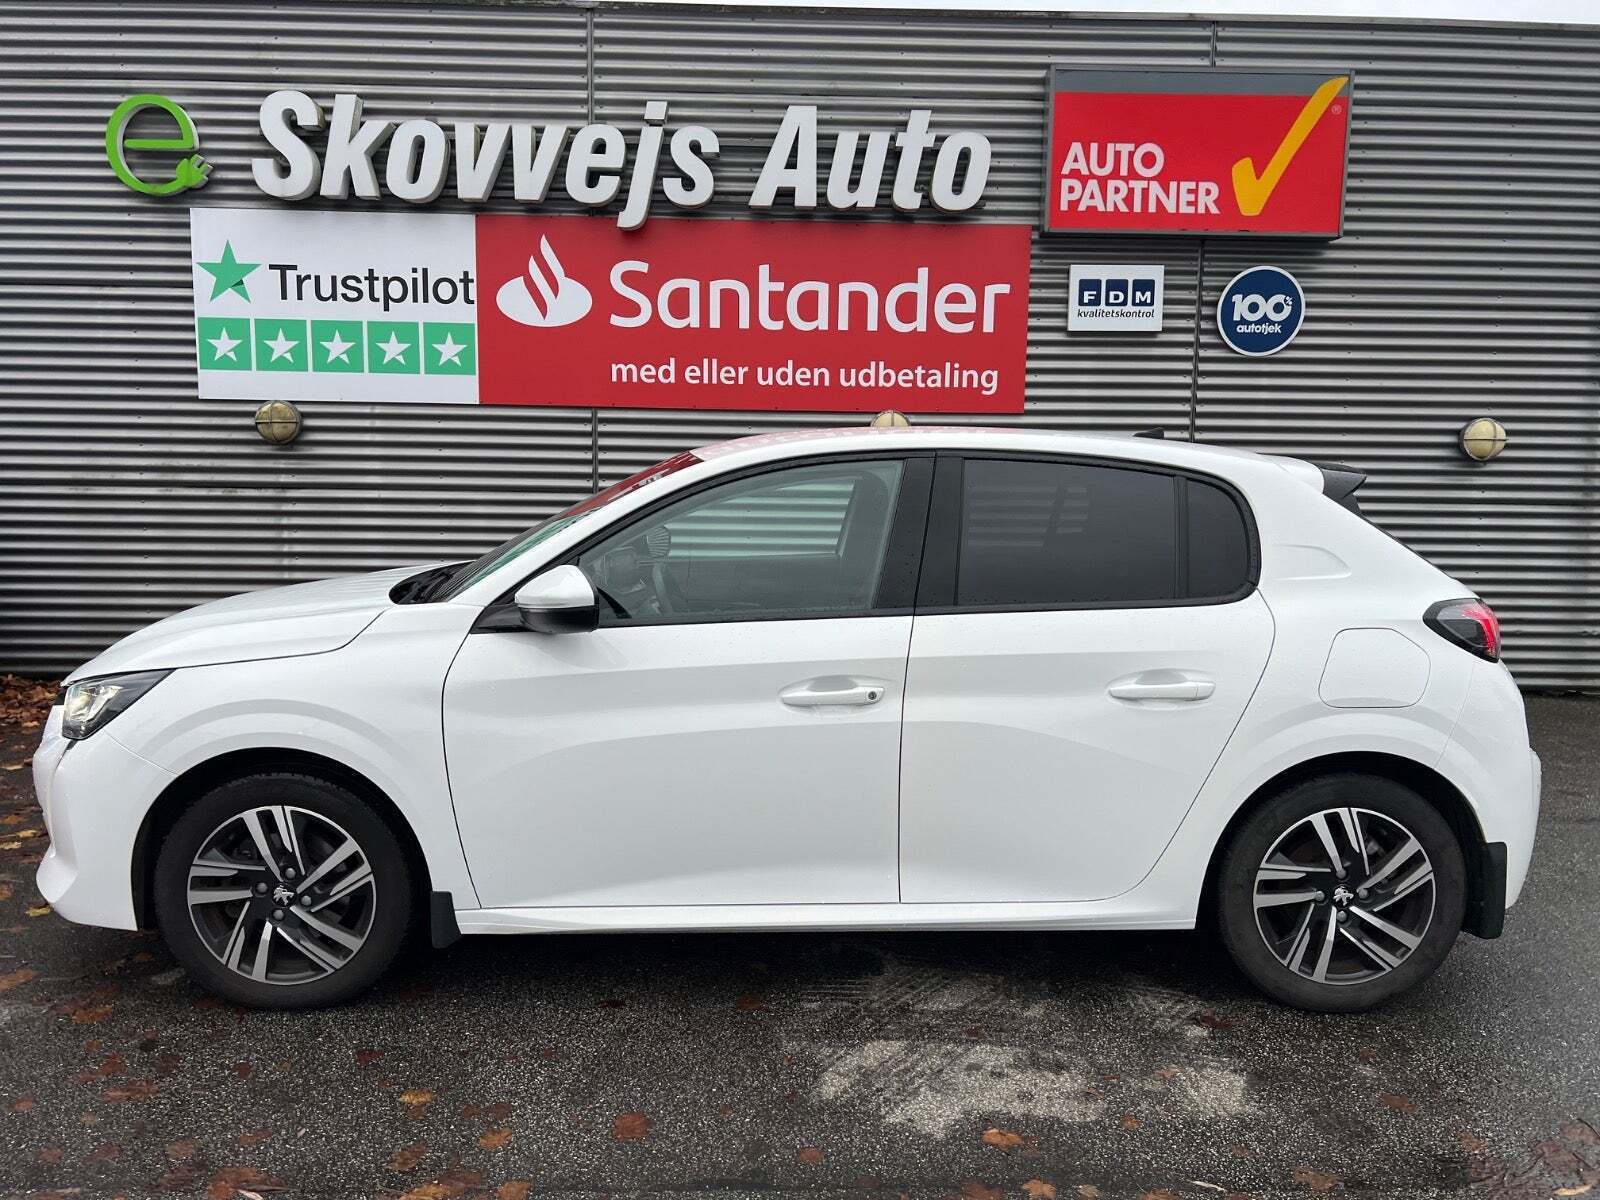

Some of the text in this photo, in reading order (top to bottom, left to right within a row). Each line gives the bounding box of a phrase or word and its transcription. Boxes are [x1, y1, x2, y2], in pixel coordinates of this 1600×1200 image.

[252, 90, 992, 231] Skovvejs Auto
[1061, 142, 1165, 178] AUTO
[1059, 178, 1221, 215] PARTNER
[268, 264, 475, 313] Trustpilot
[608, 260, 1012, 334] Santander
[1077, 307, 1156, 319] kvalitetskontrol
[1231, 293, 1294, 322] 100%
[1235, 322, 1282, 335] autotjek
[611, 357, 999, 396] med eller uden udbetaling
